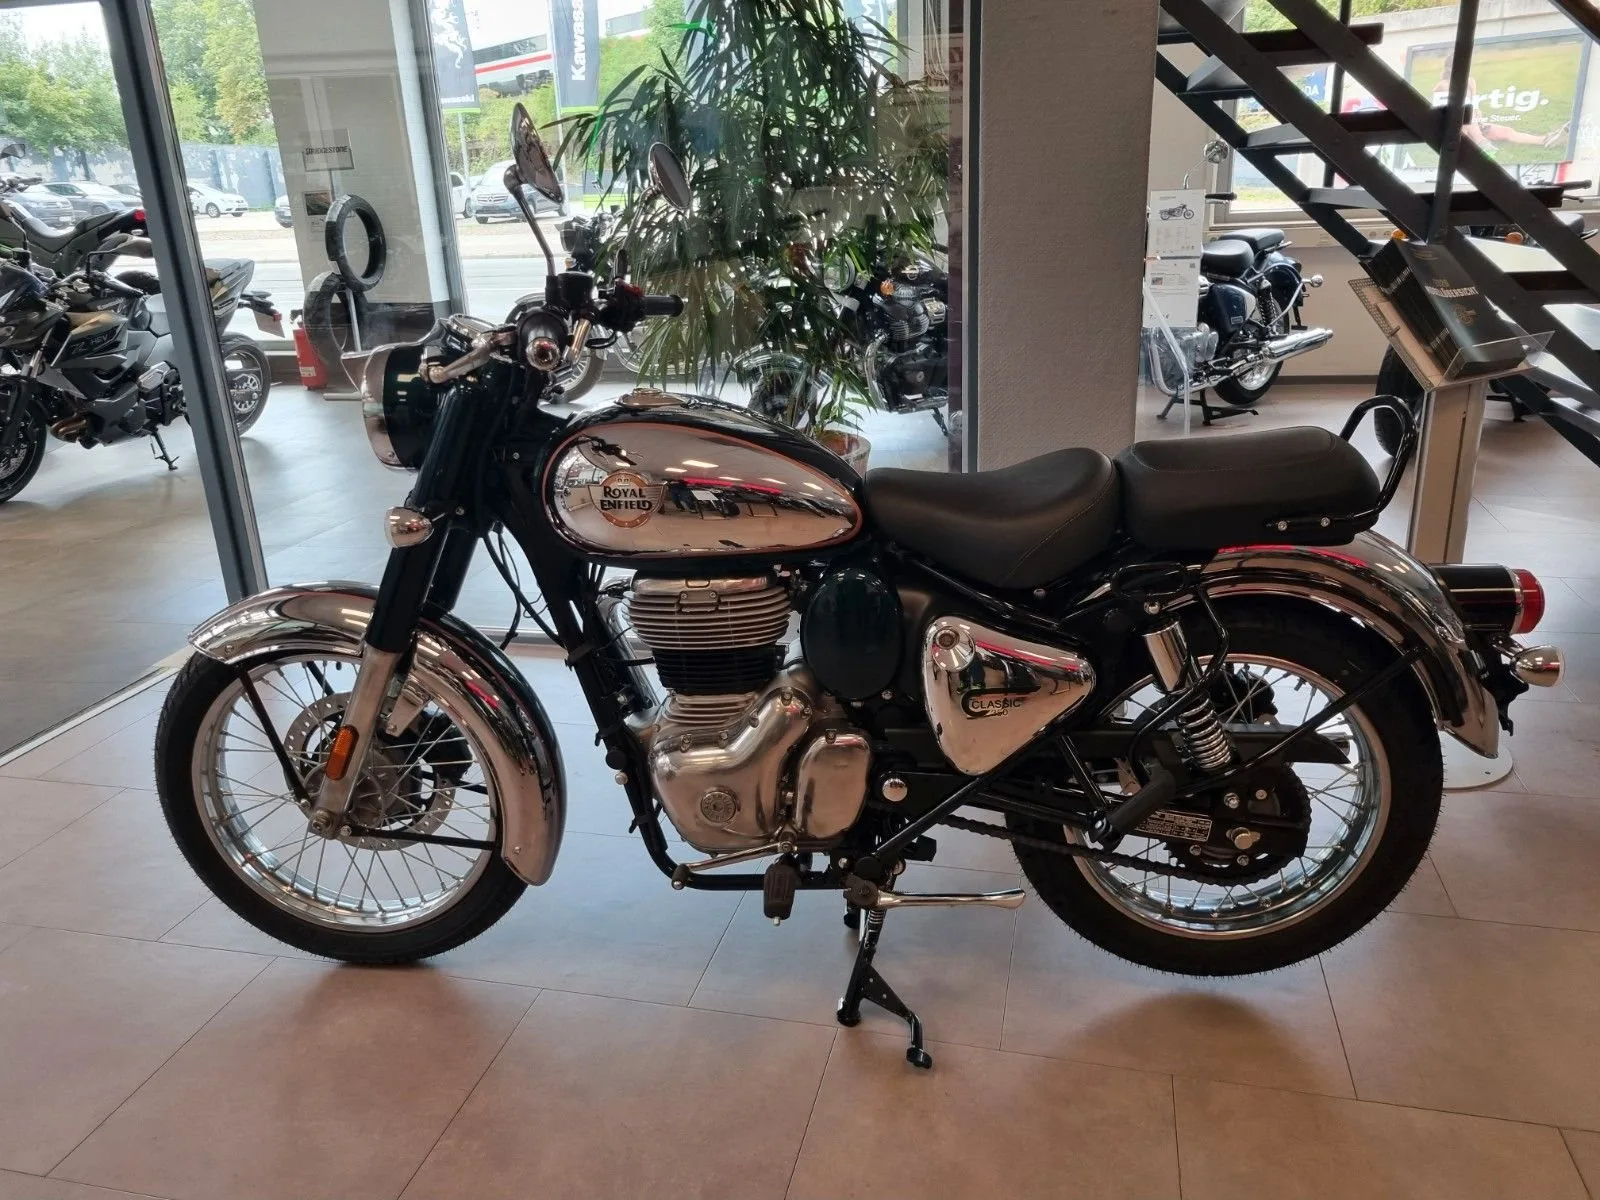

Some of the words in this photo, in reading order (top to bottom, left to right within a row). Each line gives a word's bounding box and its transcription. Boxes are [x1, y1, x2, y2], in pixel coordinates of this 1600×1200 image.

[1433, 86, 1549, 112] Frtig.
[603, 486, 647, 499] ROYAL
[600, 499, 653, 511] ENFIELD
[971, 699, 1021, 709] CLASSIC
